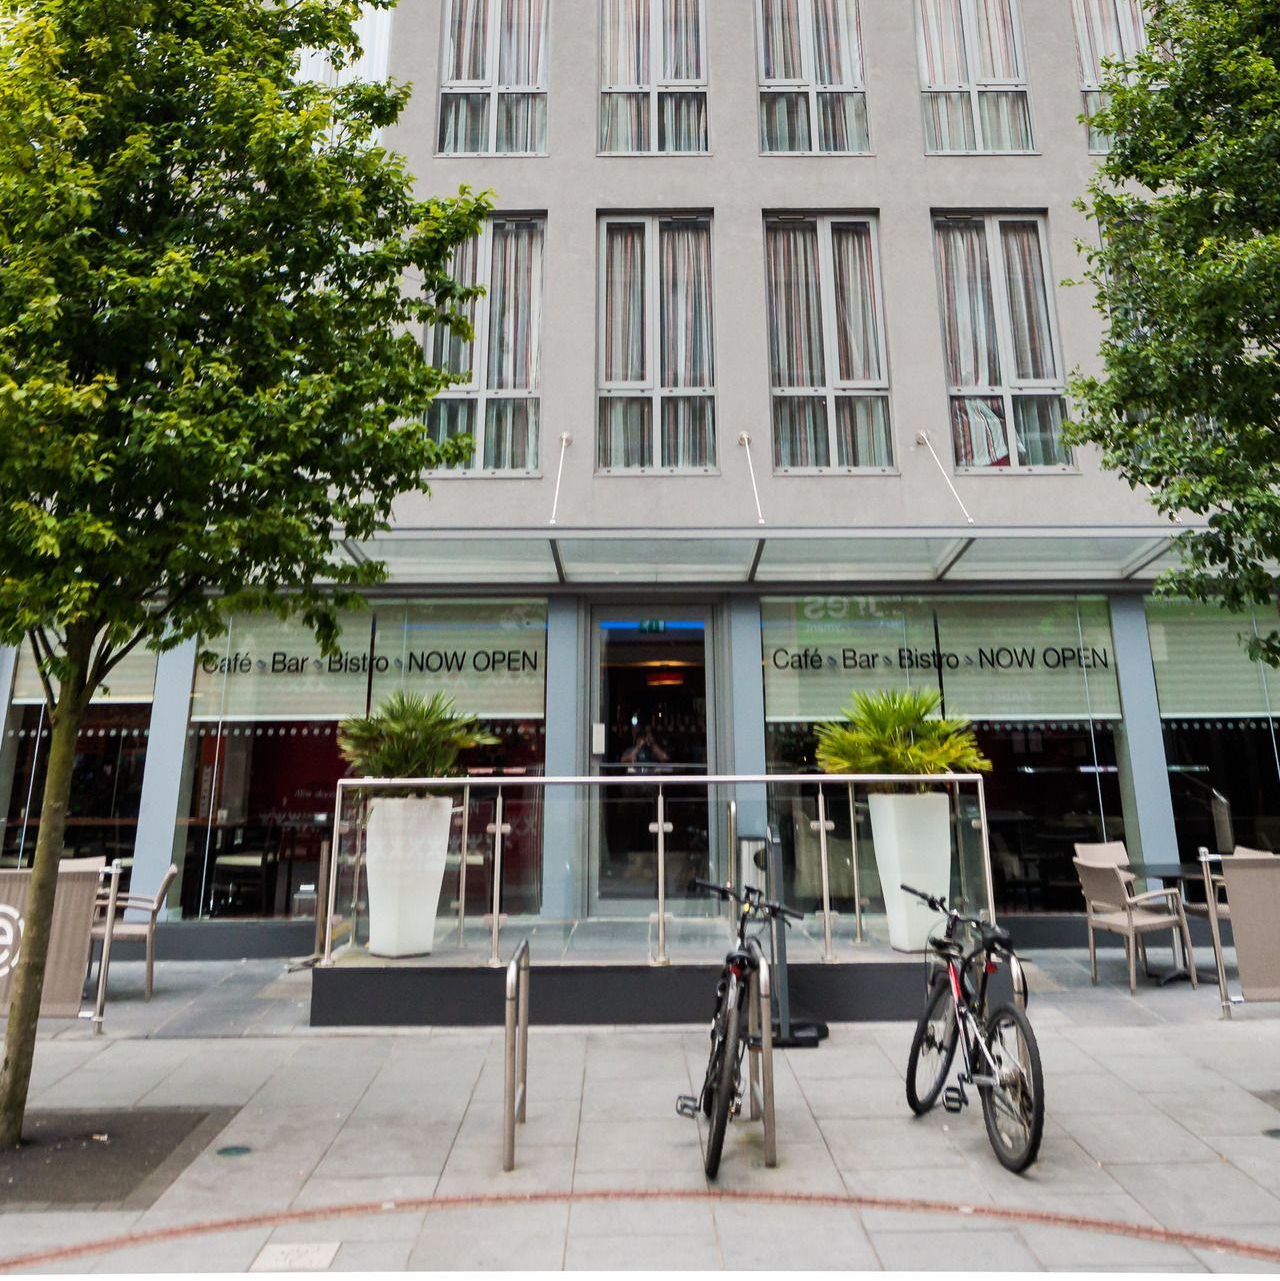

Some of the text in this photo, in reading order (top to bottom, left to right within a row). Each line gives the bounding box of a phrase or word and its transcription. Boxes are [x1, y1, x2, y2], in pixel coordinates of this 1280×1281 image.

[203, 650, 538, 674] Café Bar Bistro NOW OPEN
[772, 647, 1109, 670] Café Bar Bistro NOW OPEN
